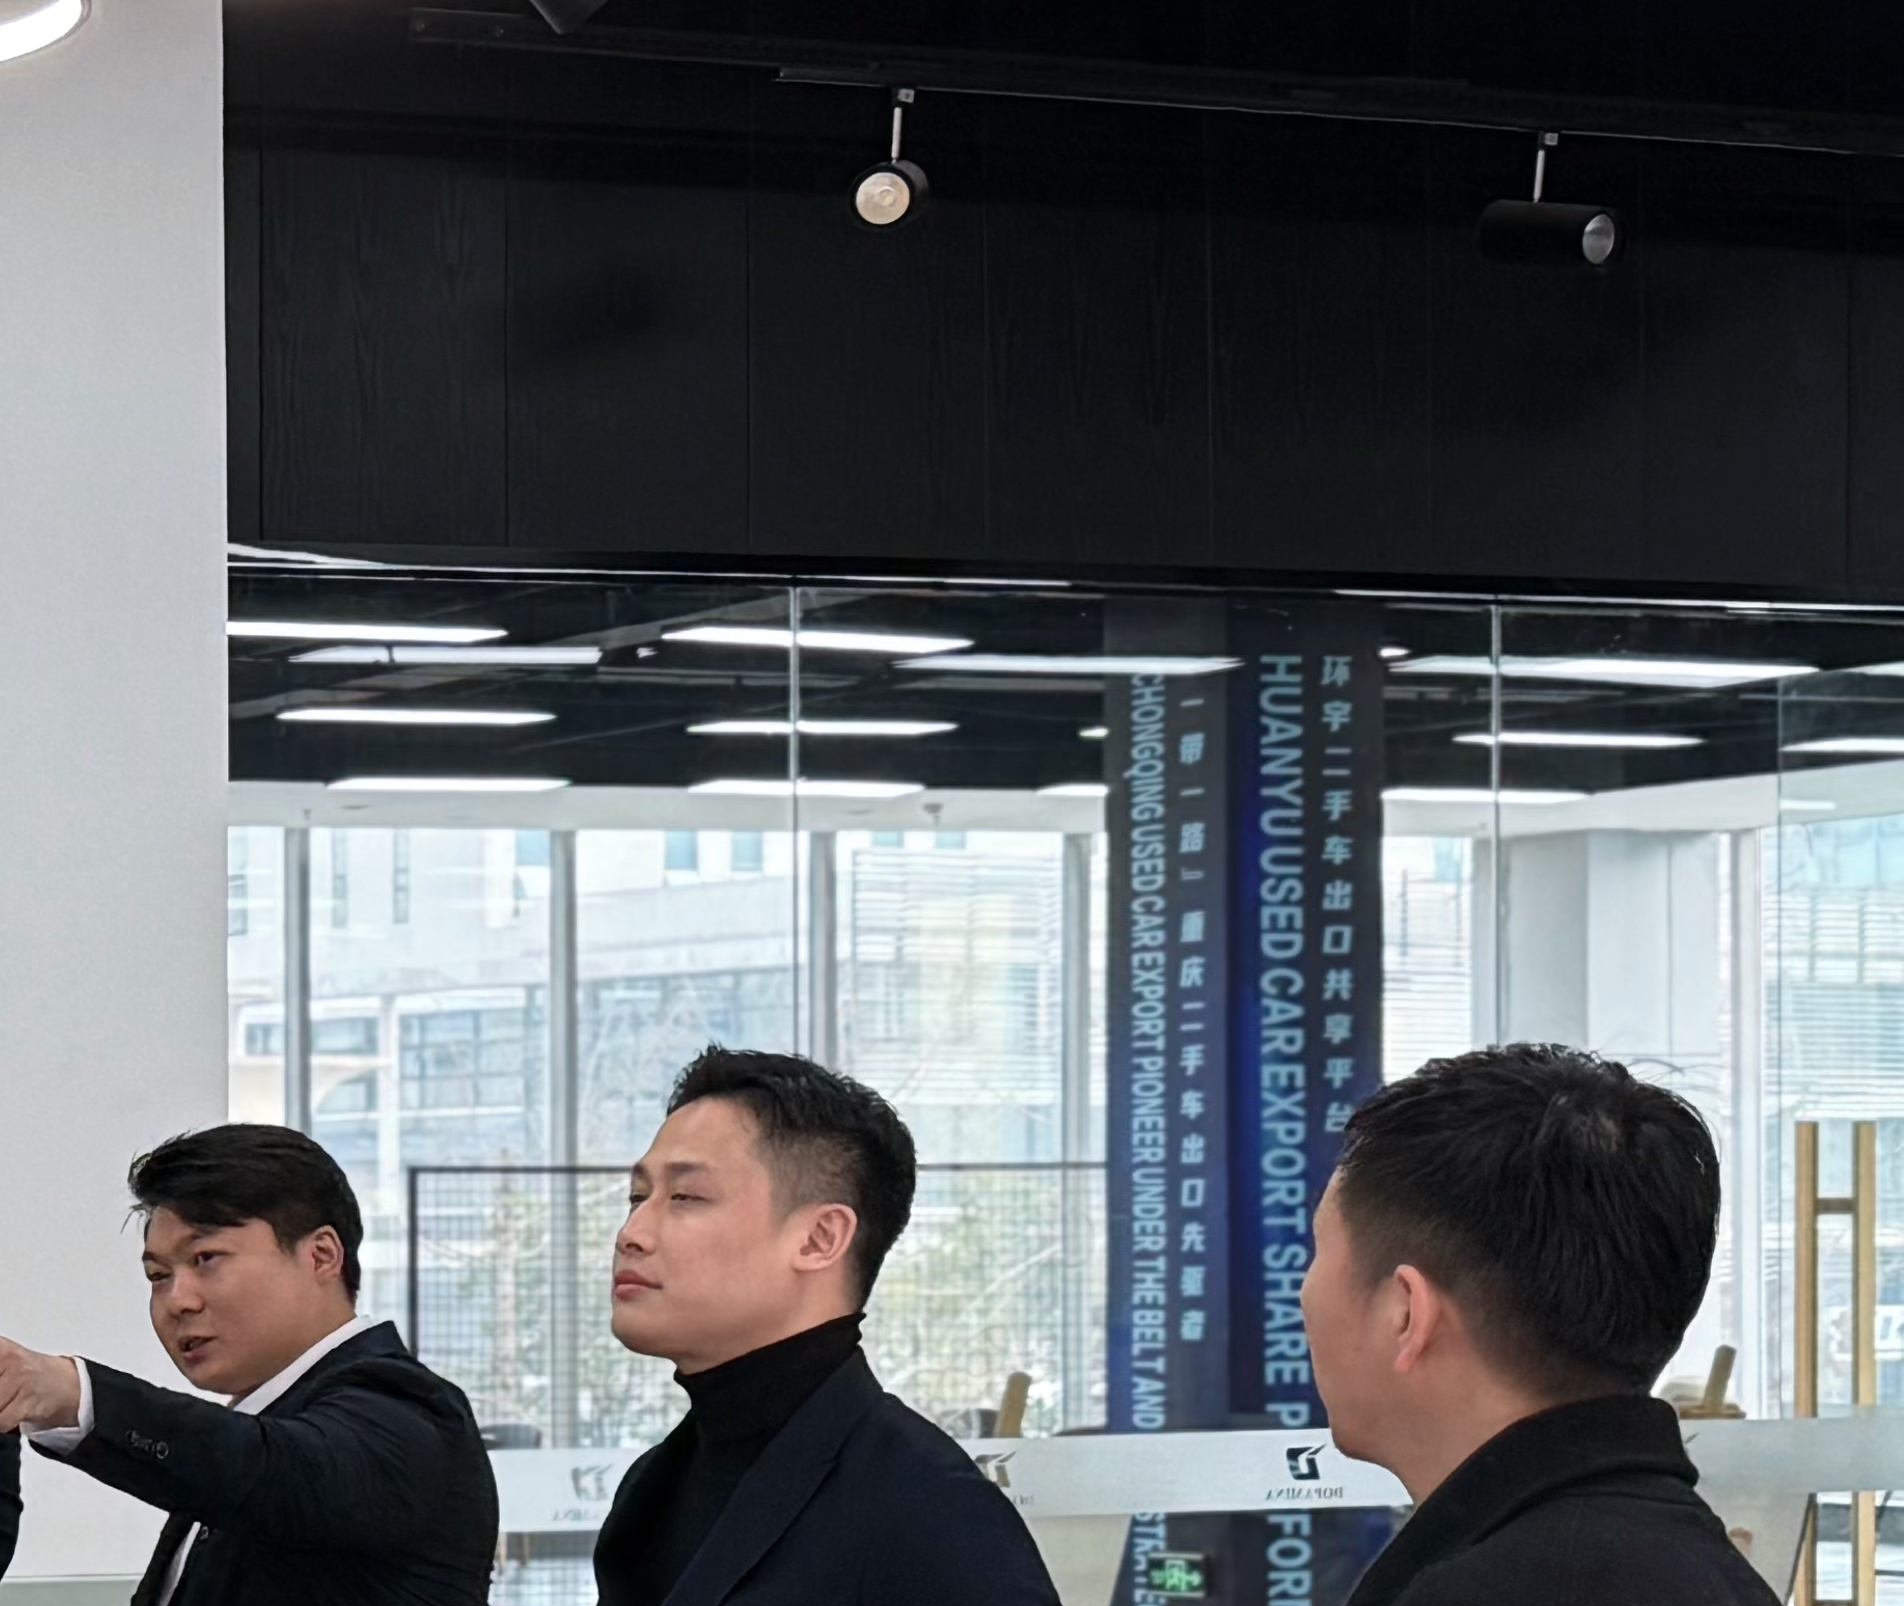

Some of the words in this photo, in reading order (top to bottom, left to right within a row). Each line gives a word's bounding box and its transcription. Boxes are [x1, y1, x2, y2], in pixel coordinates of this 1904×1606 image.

[1260, 655, 1304, 836] HUANYU
[1131, 824, 1165, 892] USED
[1131, 896, 1165, 948] CAR
[1260, 847, 1304, 960] USED
[1131, 952, 1166, 1051] EXPORT
[1260, 968, 1305, 1055] CAR
[1132, 1056, 1166, 1163] PIONEER
[1261, 1065, 1307, 1234] EXPORT
[1132, 1167, 1167, 1250] UNDER
[1132, 1256, 1167, 1305] THE
[1263, 1244, 1310, 1385] SHARE
[1132, 1310, 1166, 1373] BELT
[1132, 1376, 1166, 1430] AND
